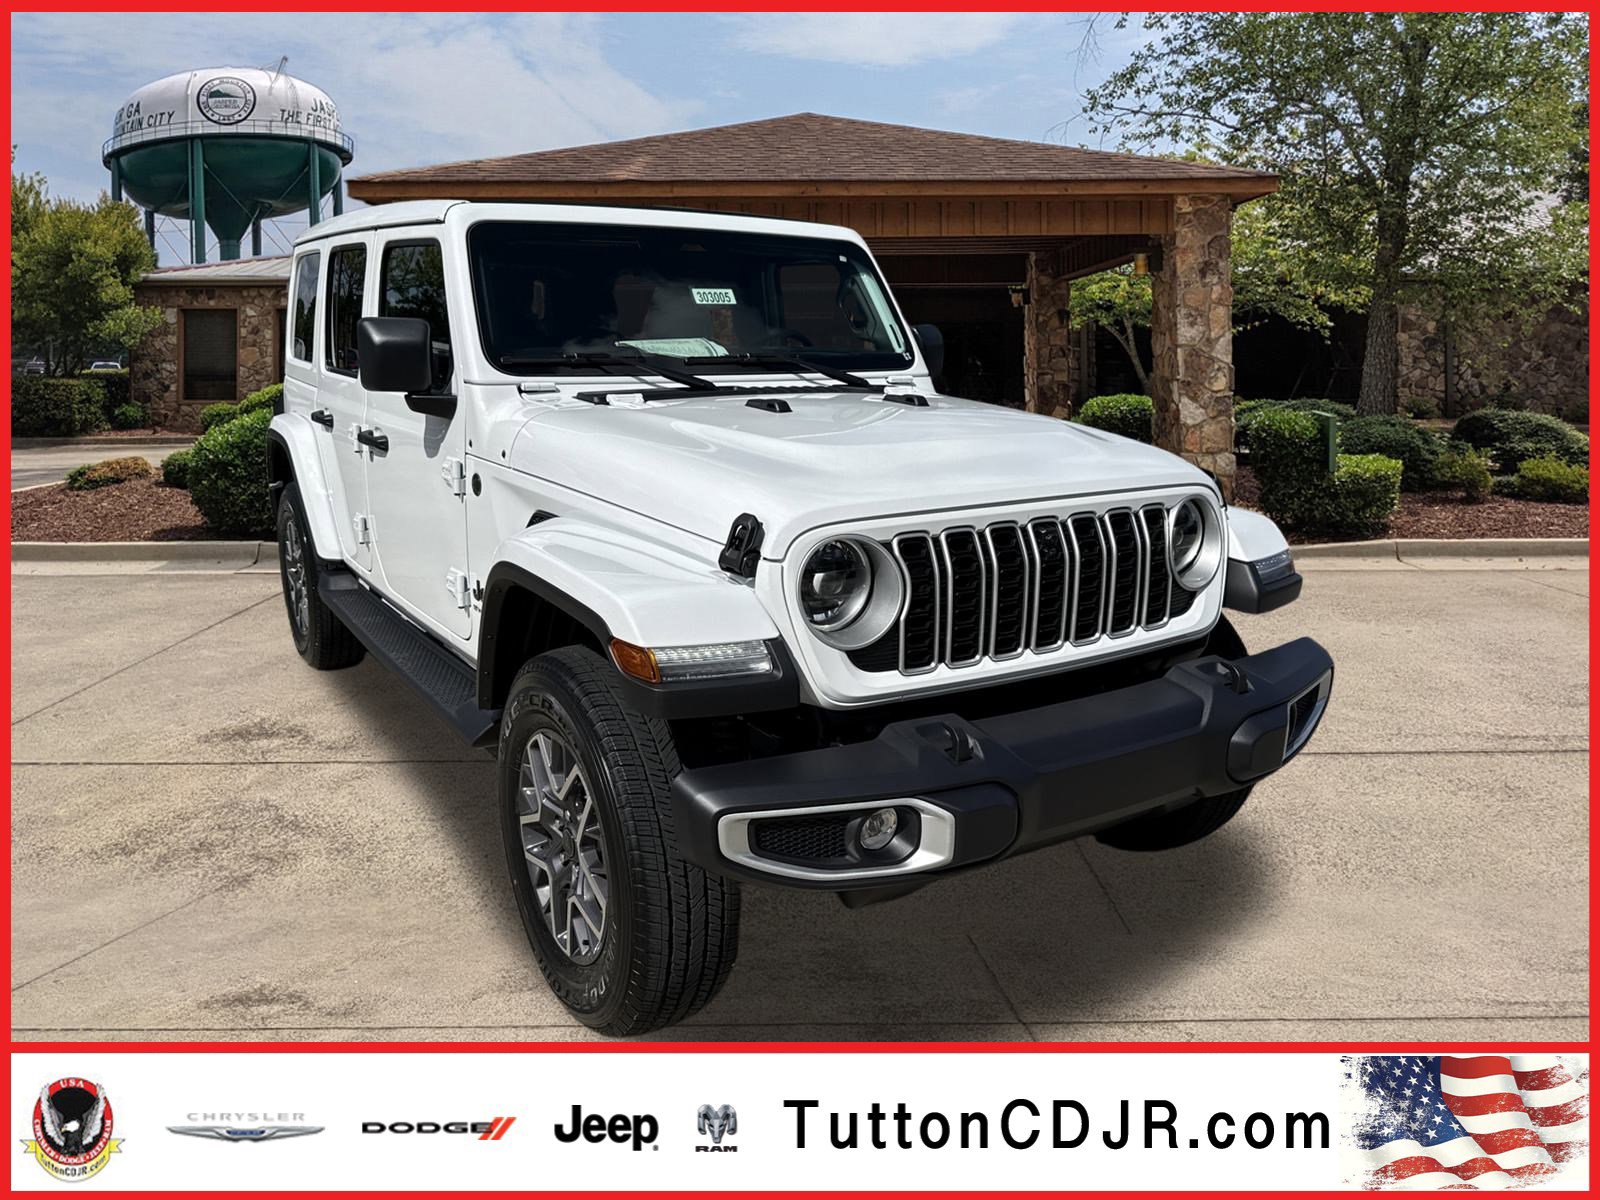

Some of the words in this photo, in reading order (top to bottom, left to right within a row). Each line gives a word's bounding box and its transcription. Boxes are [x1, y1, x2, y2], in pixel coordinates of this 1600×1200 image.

[126, 101, 141, 119] GA
[147, 110, 175, 127] CITY
[280, 108, 302, 124] THE
[306, 112, 331, 129] FIRST
[696, 291, 731, 303] 303005
